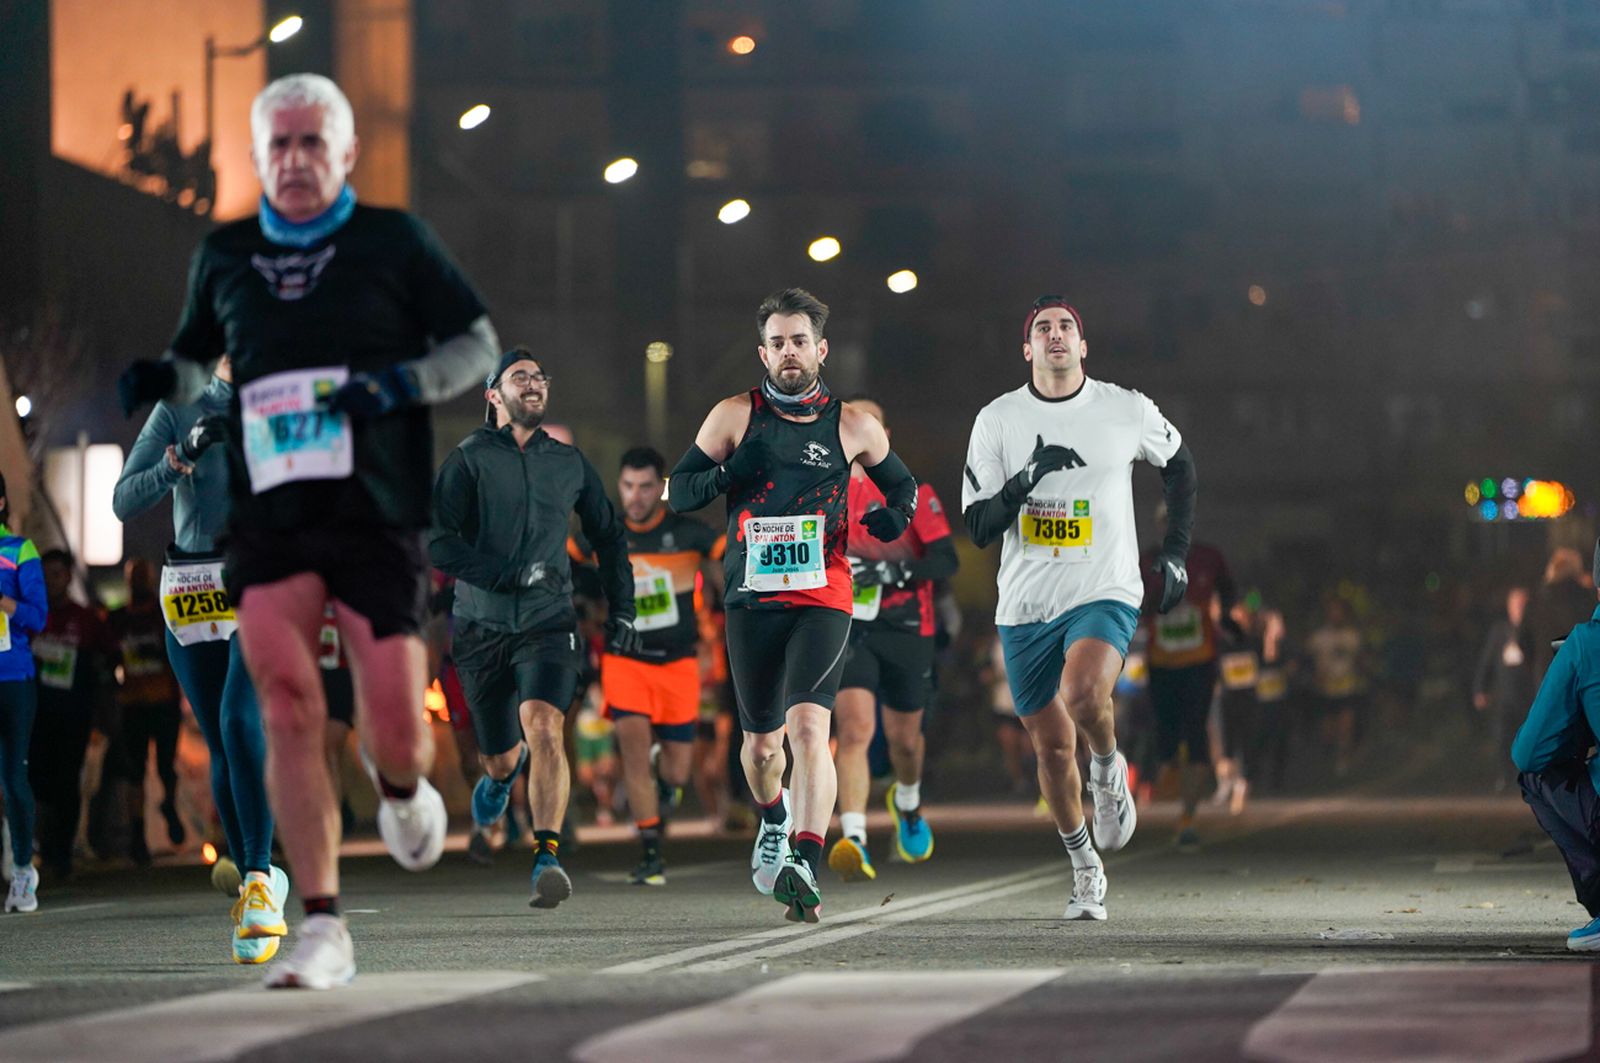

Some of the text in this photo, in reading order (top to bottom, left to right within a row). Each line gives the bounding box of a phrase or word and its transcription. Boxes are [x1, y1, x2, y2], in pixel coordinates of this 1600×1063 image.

[1034, 501, 1056, 509] NOCHE
[1057, 501, 1066, 509] DE
[1027, 508, 1040, 517] SAN
[785, 525, 795, 533] DE
[1033, 517, 1080, 539] 7385
[770, 533, 796, 542] ANTÓN
[760, 542, 810, 566] 9310
[177, 575, 200, 583] NOCHE
[168, 586, 184, 594] SAN
[171, 591, 229, 618] 1258
